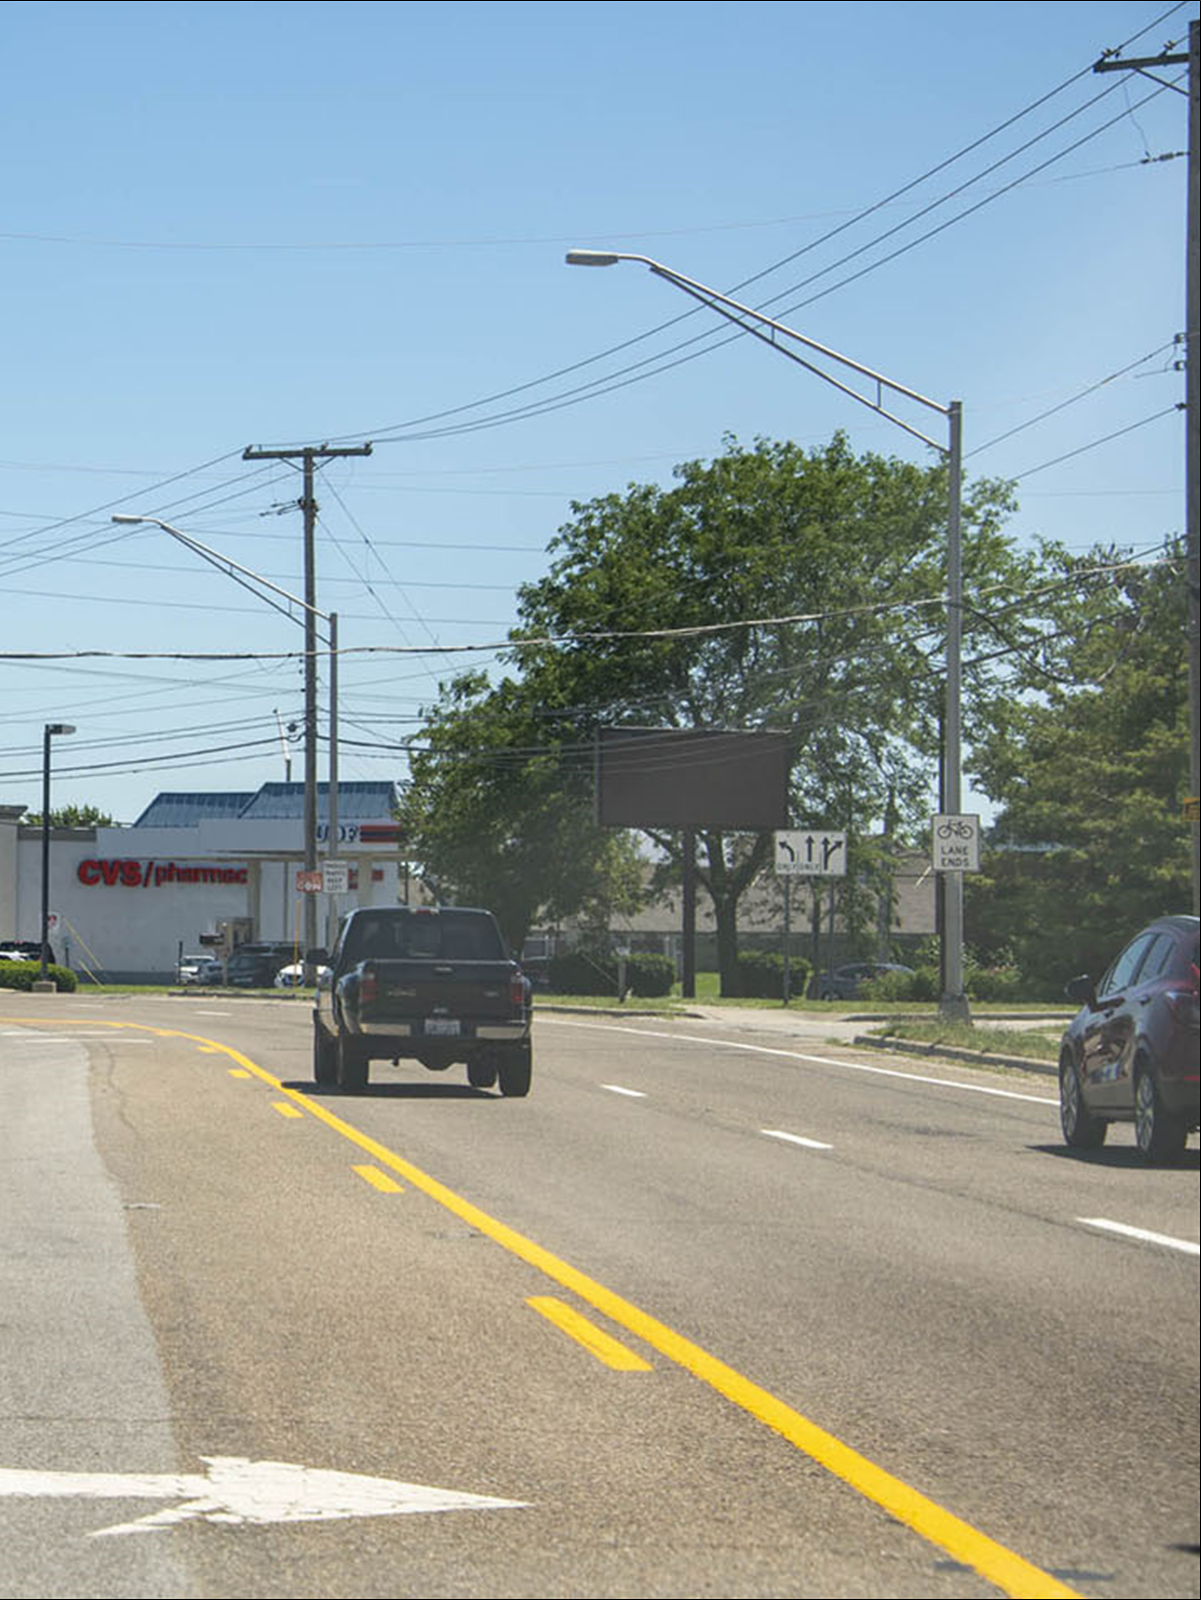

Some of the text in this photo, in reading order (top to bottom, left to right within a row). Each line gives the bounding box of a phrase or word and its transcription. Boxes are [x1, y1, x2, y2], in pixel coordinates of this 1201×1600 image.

[941, 845, 969, 855] LANE
[777, 862, 797, 871] ONLY
[798, 862, 820, 871] ONLY
[941, 857, 970, 867] ENDS
